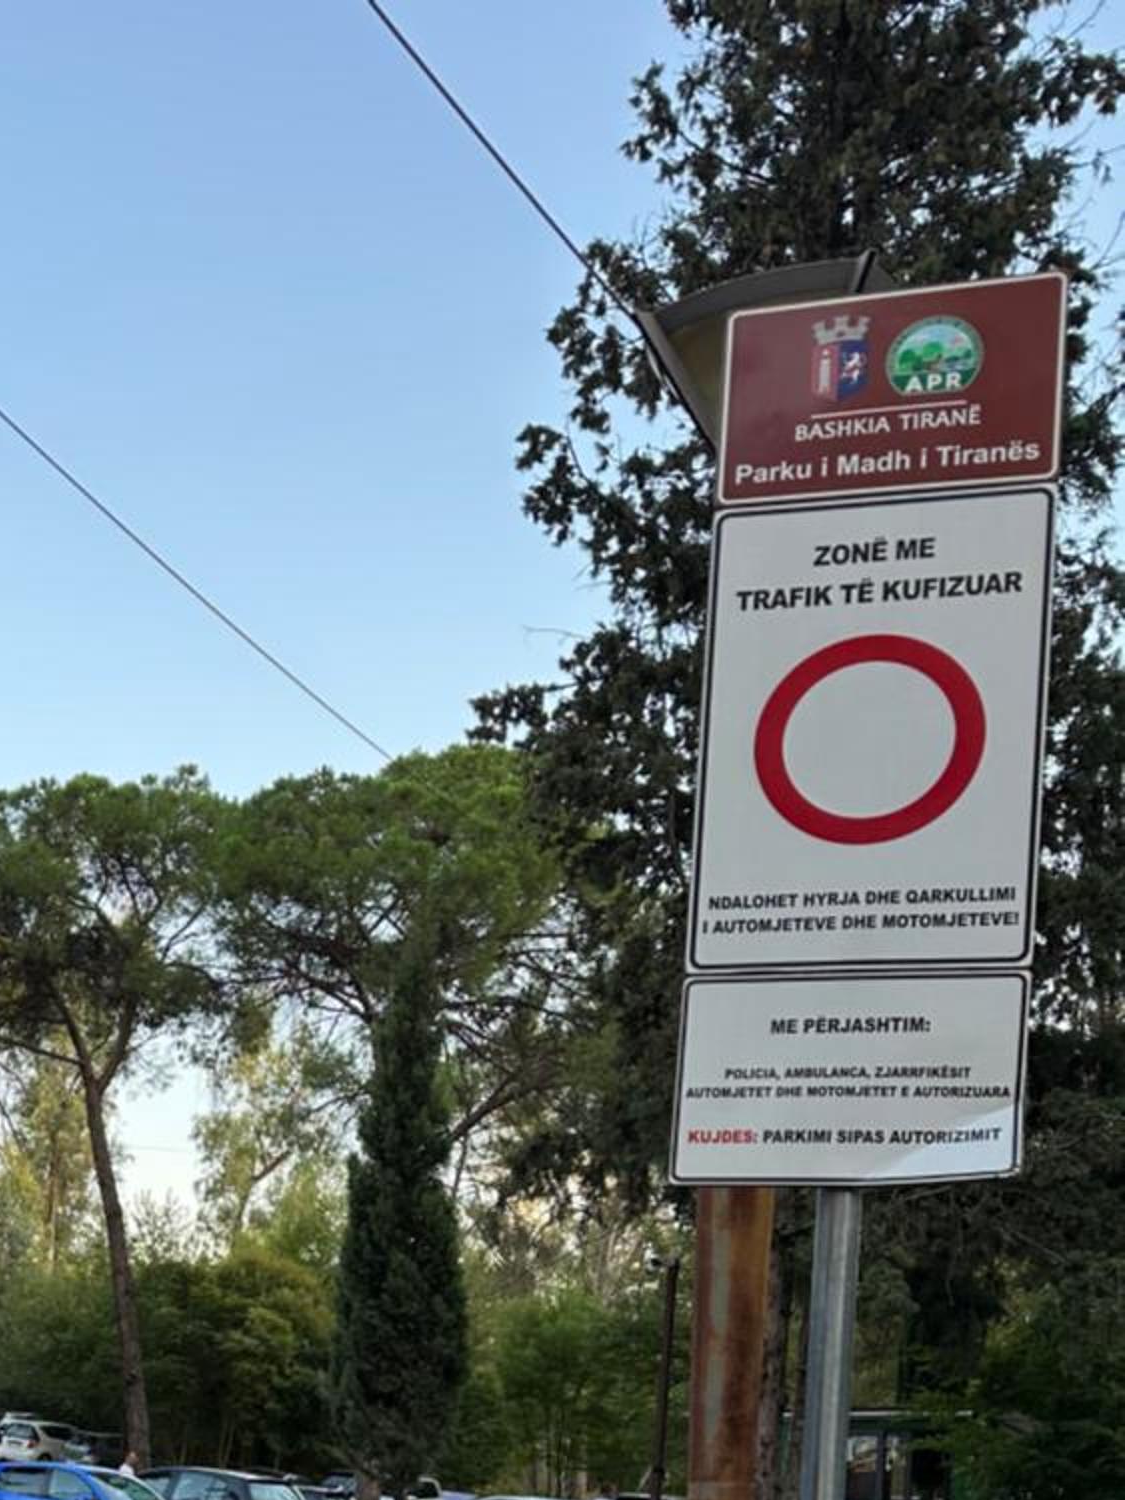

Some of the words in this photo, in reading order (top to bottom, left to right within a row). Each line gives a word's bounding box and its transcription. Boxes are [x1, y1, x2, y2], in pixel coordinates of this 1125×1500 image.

[905, 371, 963, 393] APR
[794, 416, 890, 442] BASHKIA
[898, 404, 981, 431] TIRANË
[735, 458, 812, 485] Parku
[820, 457, 828, 477] i
[837, 450, 911, 476] Madh
[920, 448, 927, 470] i
[936, 441, 1040, 467] Tiranës
[813, 538, 888, 567] ZONË
[895, 538, 935, 561] ME
[736, 584, 833, 611] TRAFIK
[839, 578, 875, 605] TË
[882, 571, 1023, 602] KUFIZUAR
[708, 893, 799, 910] NDALOHET
[803, 891, 860, 907] HYRJA
[866, 889, 900, 905] DHE
[906, 886, 1016, 904] QARKULLIMI
[713, 916, 837, 934] AUTOMJETEVE
[842, 914, 876, 929] DHE
[882, 911, 1020, 929] MOTOMJETEVE!
[770, 1019, 797, 1034] ME
[803, 1016, 931, 1034] PËRJASHTIM:
[725, 1067, 780, 1081] POLICIA,
[686, 1085, 772, 1099] AUTOMJETET
[776, 1086, 802, 1098] DHE
[807, 1085, 897, 1098] MOTOMJETET
[901, 1085, 909, 1097] E
[913, 1085, 1011, 1099] AUTORIZUARA
[688, 1129, 757, 1144] KUJDES:
[762, 1130, 832, 1144] PARKIMI
[836, 1131, 885, 1144] SIPAS
[889, 1127, 1002, 1145] AUTORIZIMIT
